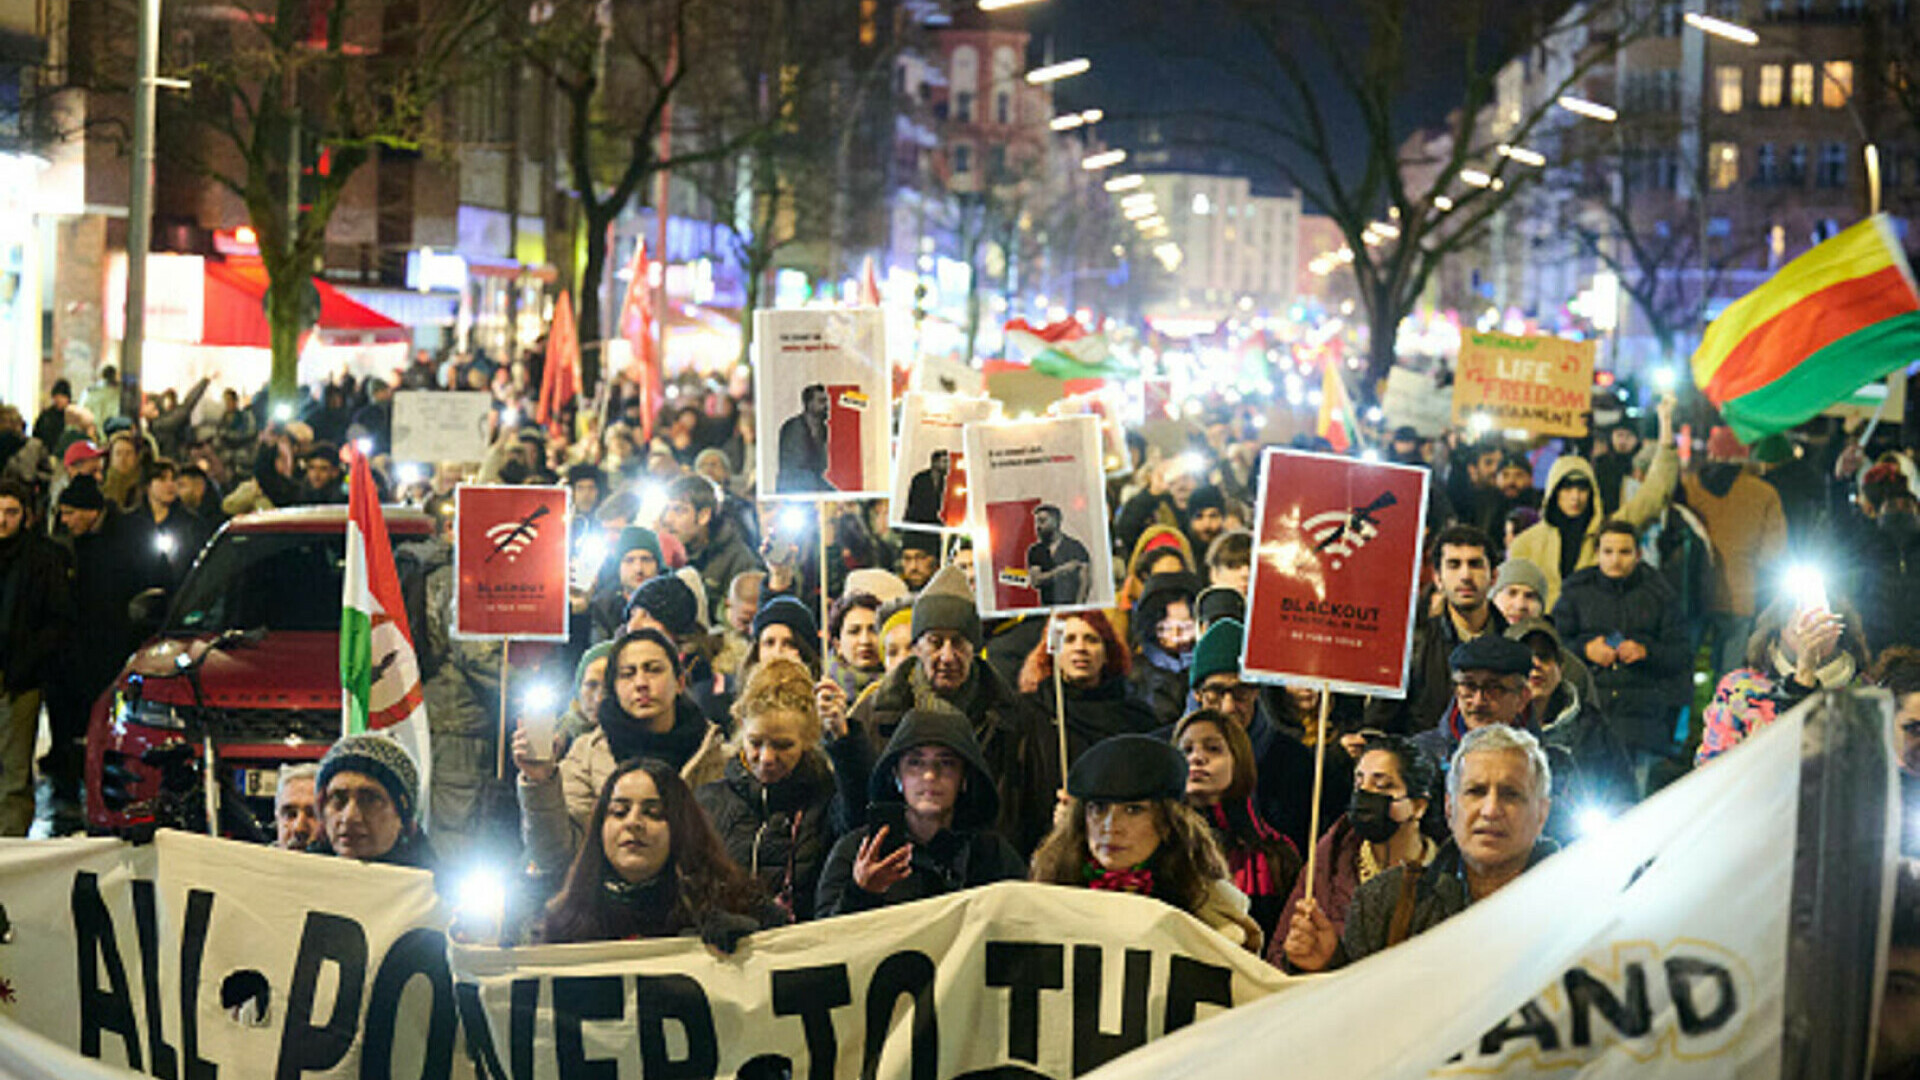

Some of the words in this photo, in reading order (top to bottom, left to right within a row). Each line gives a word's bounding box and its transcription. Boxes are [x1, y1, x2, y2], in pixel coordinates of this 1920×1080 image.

[1496, 356, 1552, 384] LIFE
[1483, 379, 1586, 409] FREEDOM
[1281, 598, 1380, 622] BLACKOUT
[71, 869, 219, 1080] ALL
[1446, 955, 1739, 1064] AND
